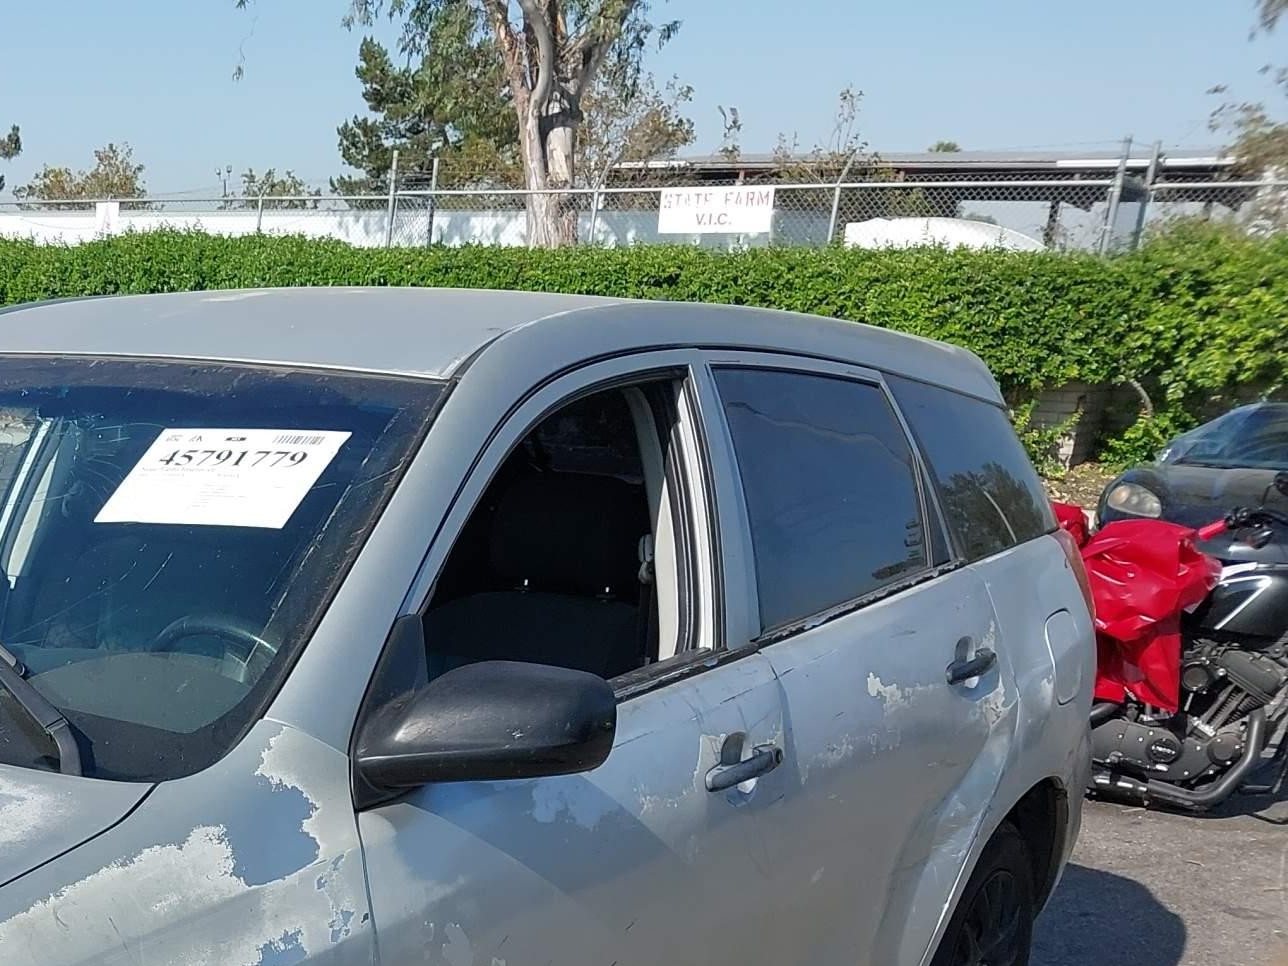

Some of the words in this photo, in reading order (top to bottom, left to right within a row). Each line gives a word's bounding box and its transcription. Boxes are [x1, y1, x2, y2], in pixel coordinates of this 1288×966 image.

[663, 192, 713, 208] STATE
[724, 190, 770, 207] FARM
[695, 212, 732, 226] V.I.C.
[159, 449, 308, 468] 45791779
